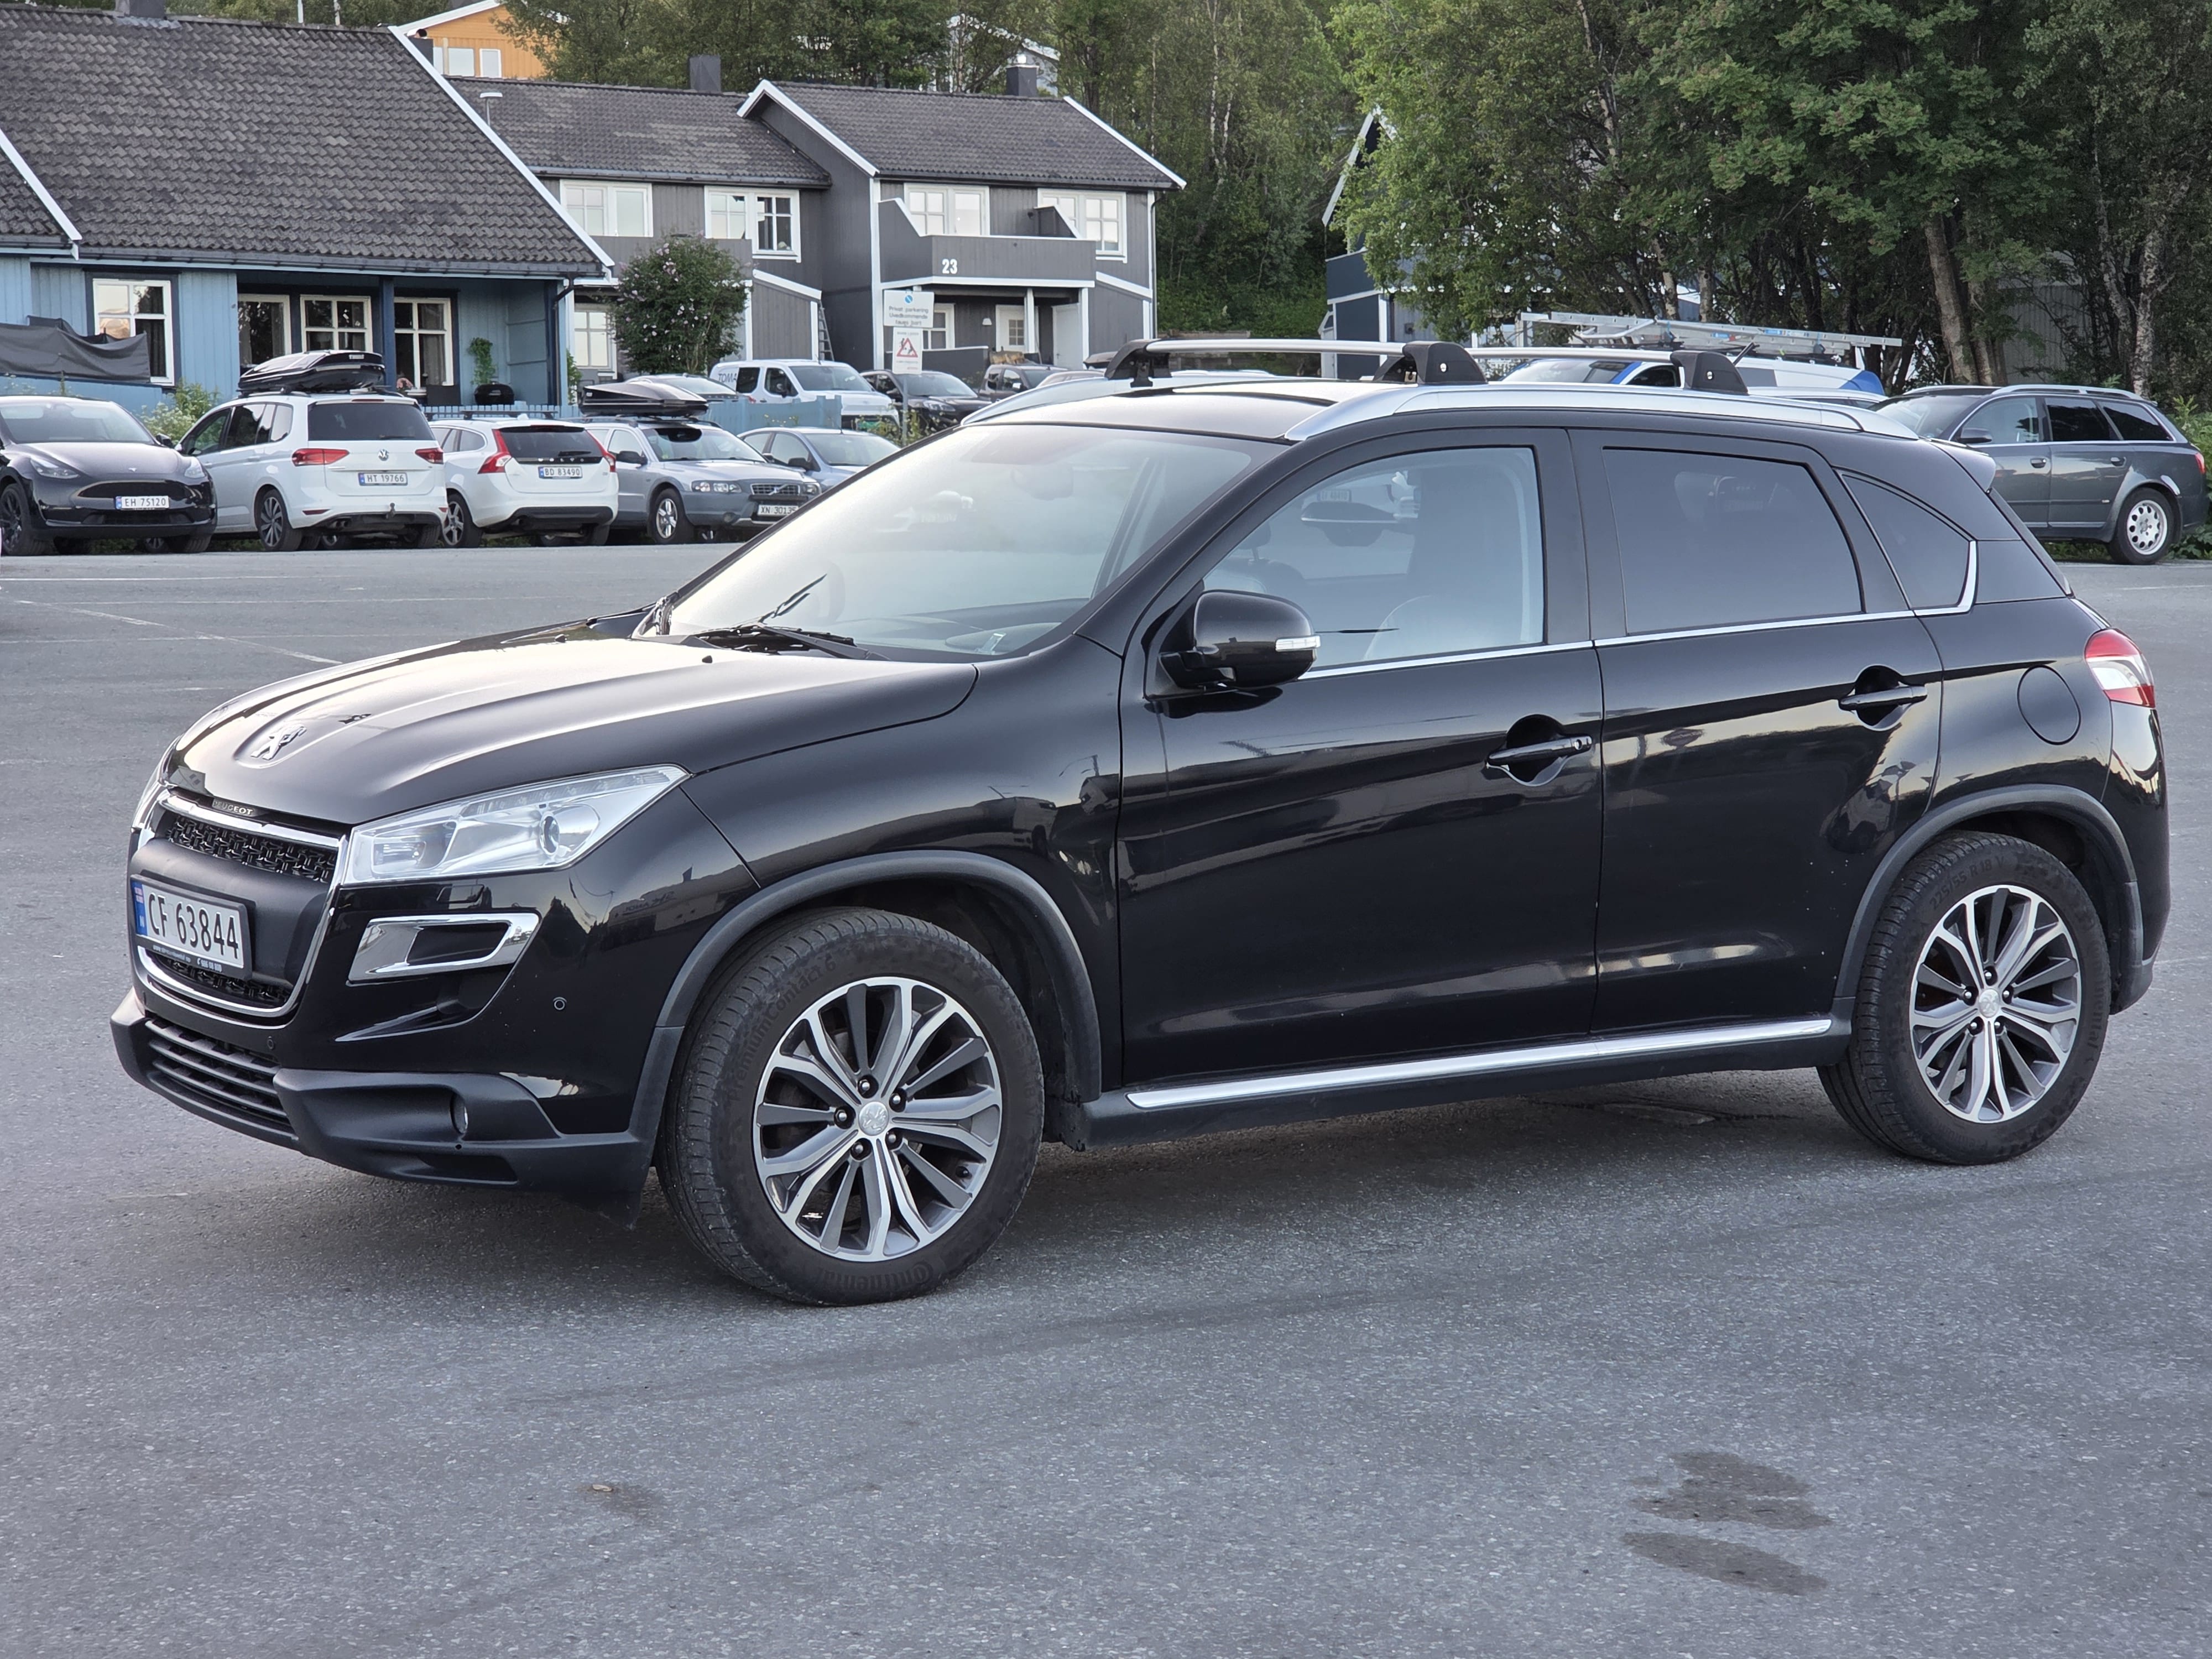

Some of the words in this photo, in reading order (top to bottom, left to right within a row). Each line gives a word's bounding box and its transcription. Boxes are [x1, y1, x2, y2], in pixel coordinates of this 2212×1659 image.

[942, 259, 958, 274] 23
[124, 498, 136, 507] EH
[140, 498, 166, 507] 75120
[213, 800, 253, 815] PEUGEOT
[1929, 870, 1968, 911] 225/55
[1969, 864, 1979, 877] R
[1980, 859, 1992, 872] 18
[148, 893, 168, 938] CF
[176, 901, 239, 960] 63844
[825, 953, 837, 972] 6
[817, 1261, 934, 1293] Continental
